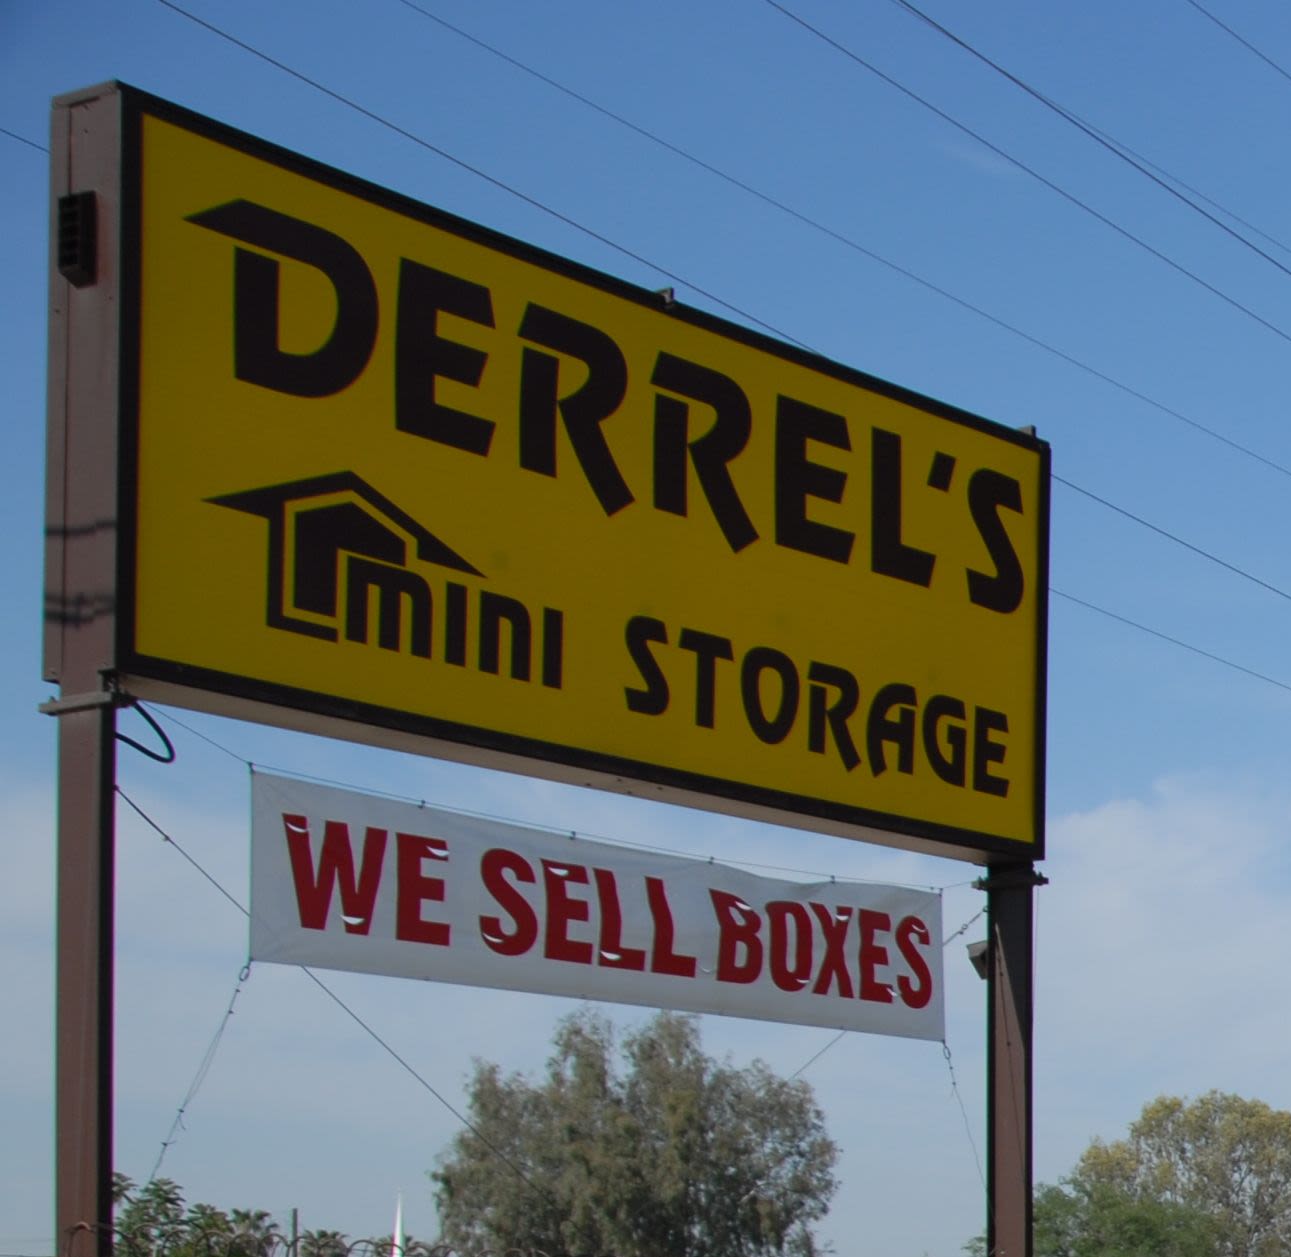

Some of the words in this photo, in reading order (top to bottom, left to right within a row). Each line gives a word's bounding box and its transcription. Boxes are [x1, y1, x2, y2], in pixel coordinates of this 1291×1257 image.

[181, 198, 1026, 614] DERREL'S
[622, 615, 1011, 798] STORAGE
[282, 813, 451, 947] WE
[479, 848, 697, 979] SELL
[709, 888, 933, 1009] BOXES
